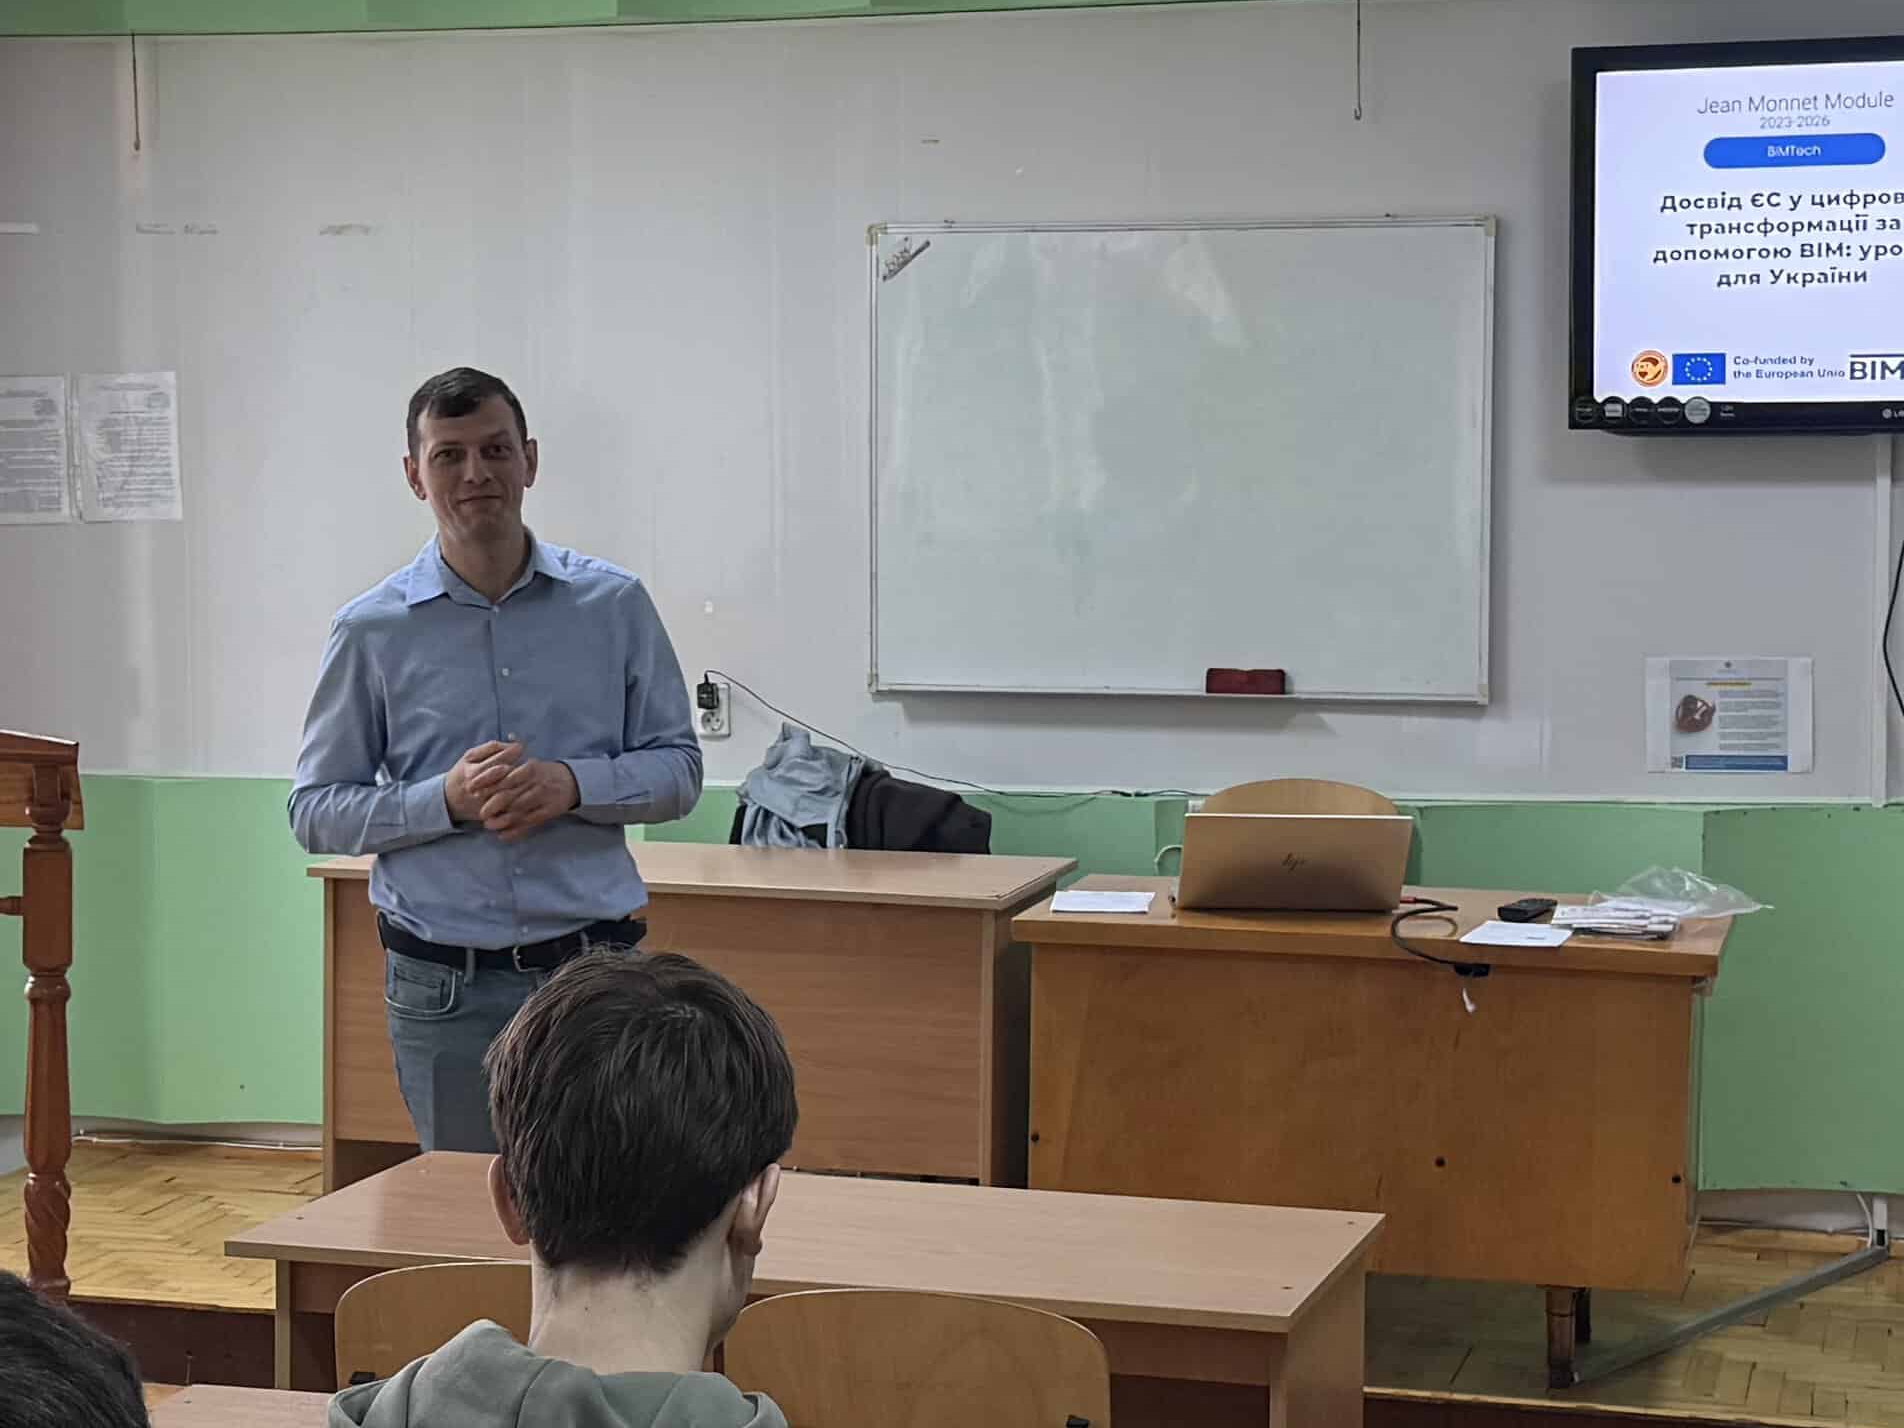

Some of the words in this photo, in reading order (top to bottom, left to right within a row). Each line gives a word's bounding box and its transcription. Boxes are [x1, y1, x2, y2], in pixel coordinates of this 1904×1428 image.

[1697, 97, 1742, 114] Jean
[1748, 94, 1818, 113] Monnet
[1824, 90, 1895, 109] Module
[1760, 115, 1831, 129] 2023-2026
[1660, 191, 1742, 212] Досвід
[1750, 192, 1781, 207] ЄС
[1789, 194, 1802, 211] у
[1686, 214, 1868, 239] трансформації
[1876, 219, 1901, 230] за
[1653, 247, 1792, 263] допомогою
[1716, 273, 1761, 287] для
[1770, 266, 1868, 287] України
[1733, 355, 1796, 366] Co-funded
[1799, 356, 1815, 368] by
[1733, 368, 1751, 379] the
[1755, 368, 1813, 381] European
